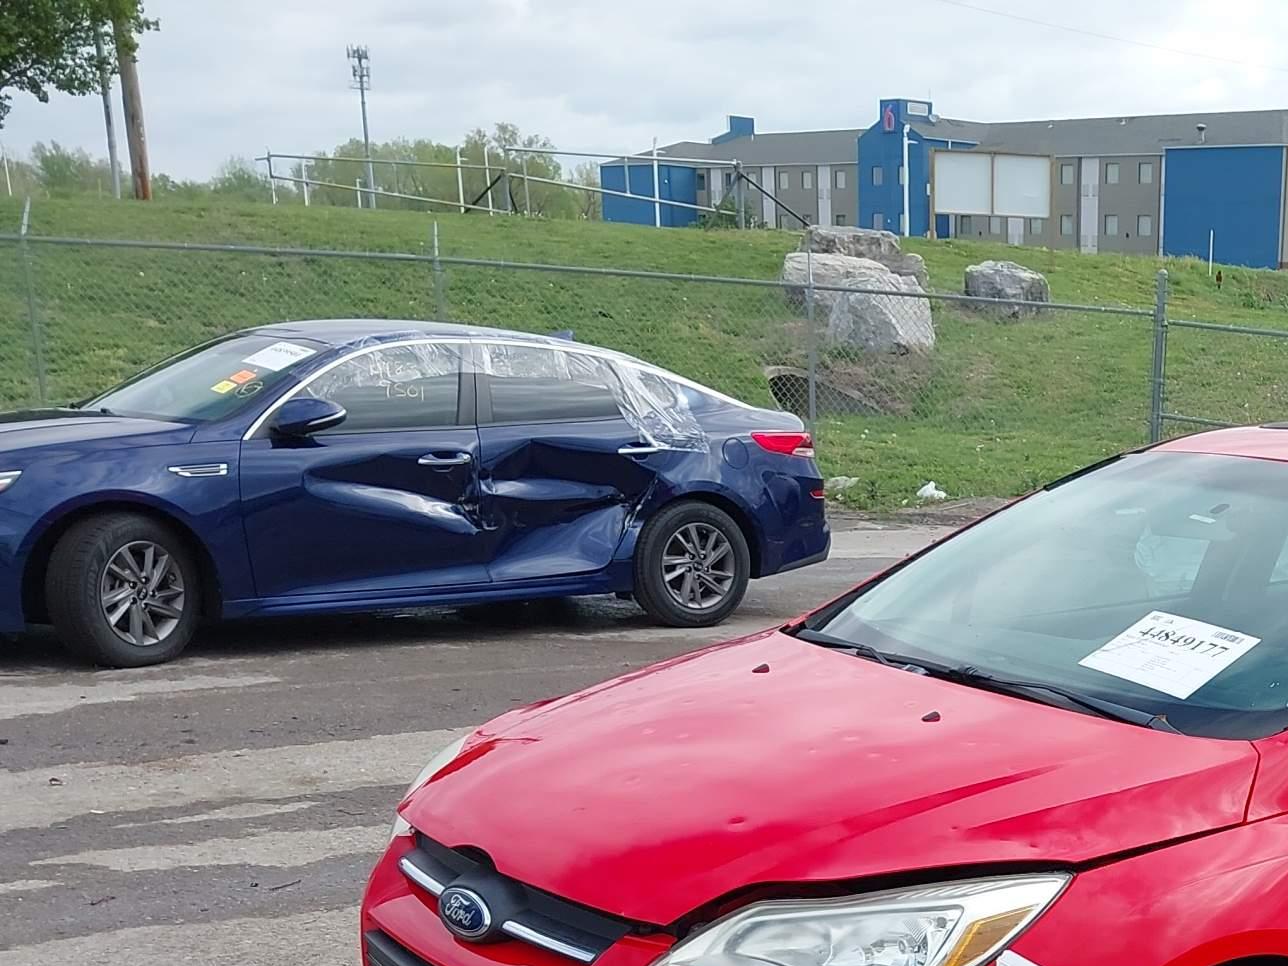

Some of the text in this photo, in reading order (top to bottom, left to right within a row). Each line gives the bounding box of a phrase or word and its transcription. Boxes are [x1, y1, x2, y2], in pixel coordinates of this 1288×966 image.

[883, 103, 895, 132] 6
[1138, 626, 1230, 658] 44849177
[444, 893, 476, 926] Ford
